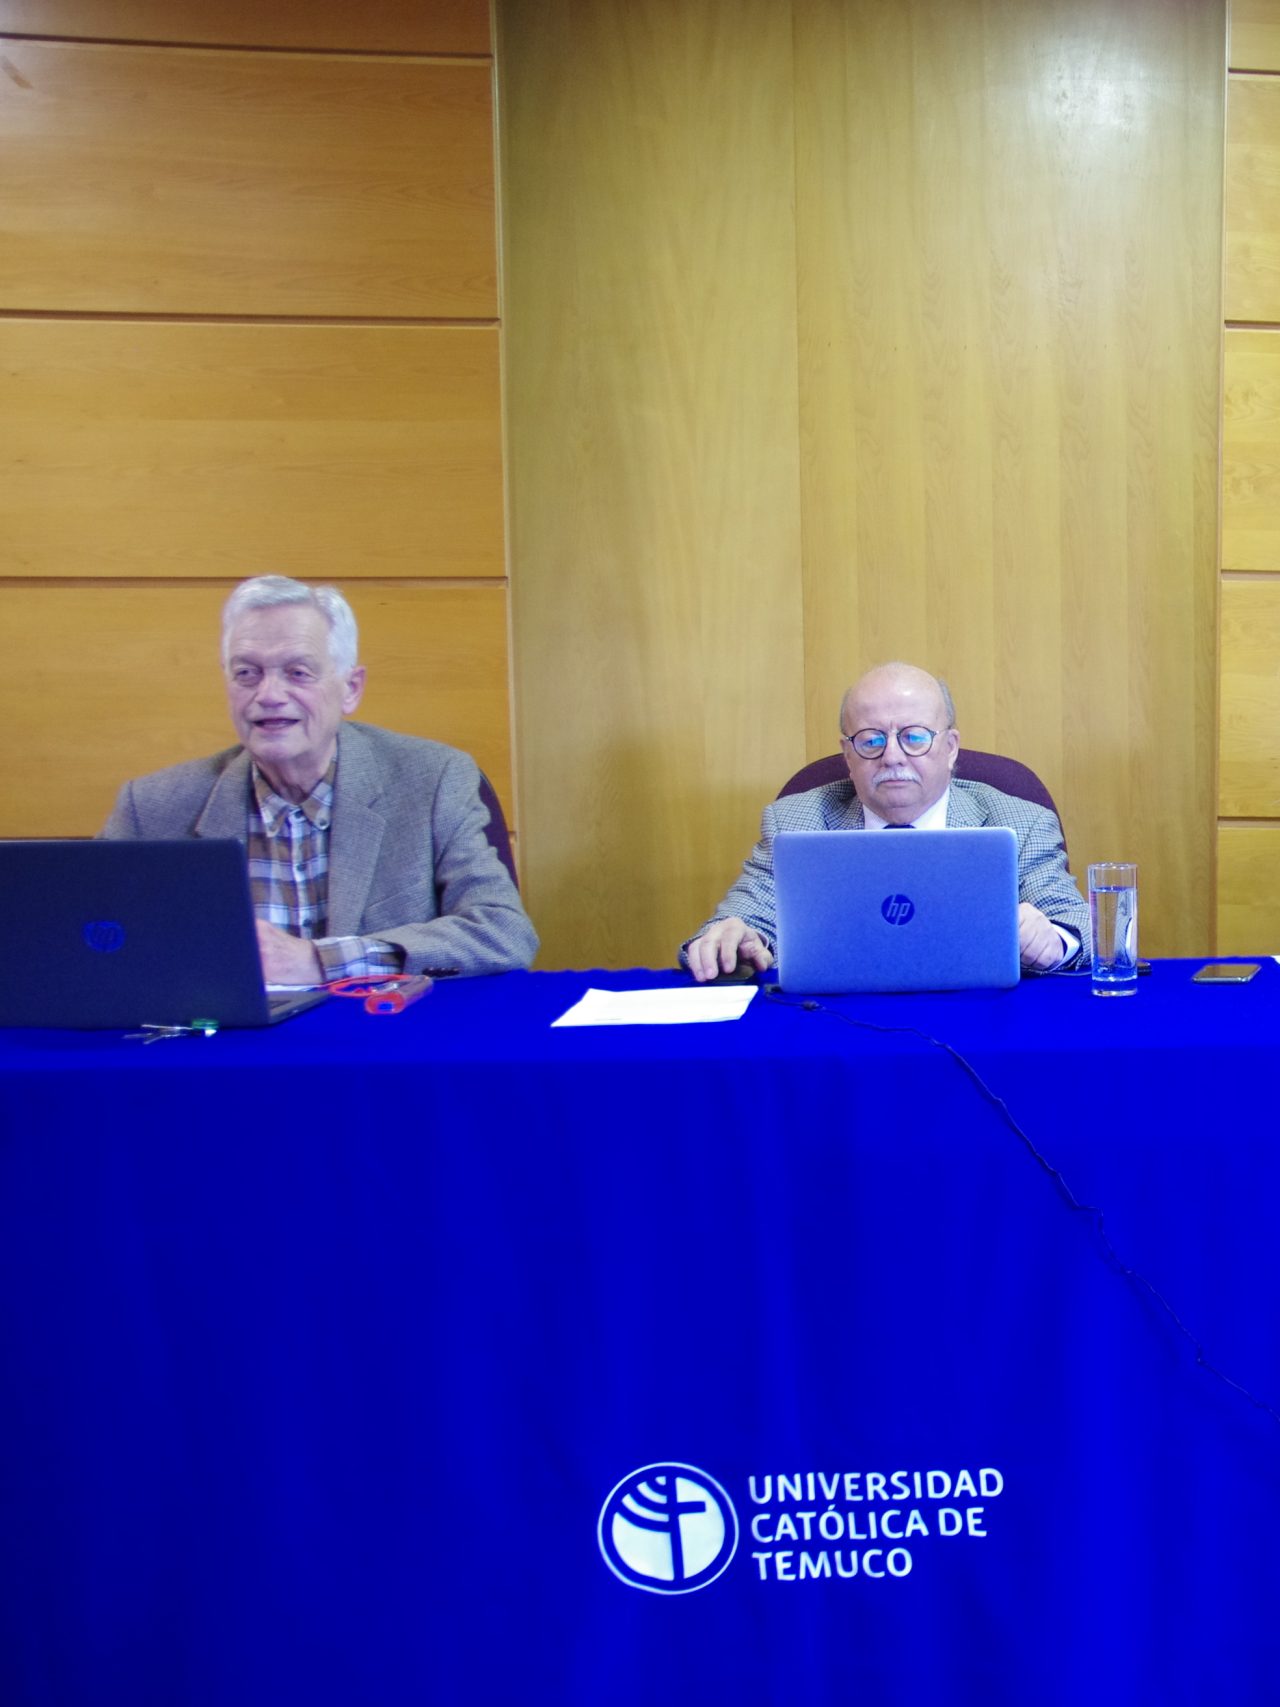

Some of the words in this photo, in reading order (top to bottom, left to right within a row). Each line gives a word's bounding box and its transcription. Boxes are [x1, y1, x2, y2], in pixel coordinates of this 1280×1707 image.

[885, 894, 911, 925] hp
[748, 1468, 1004, 1504] UNIVERSIDAD
[751, 1504, 929, 1543] CATÓLICA
[938, 1507, 987, 1537] DE
[752, 1547, 913, 1581] TEMUCO
